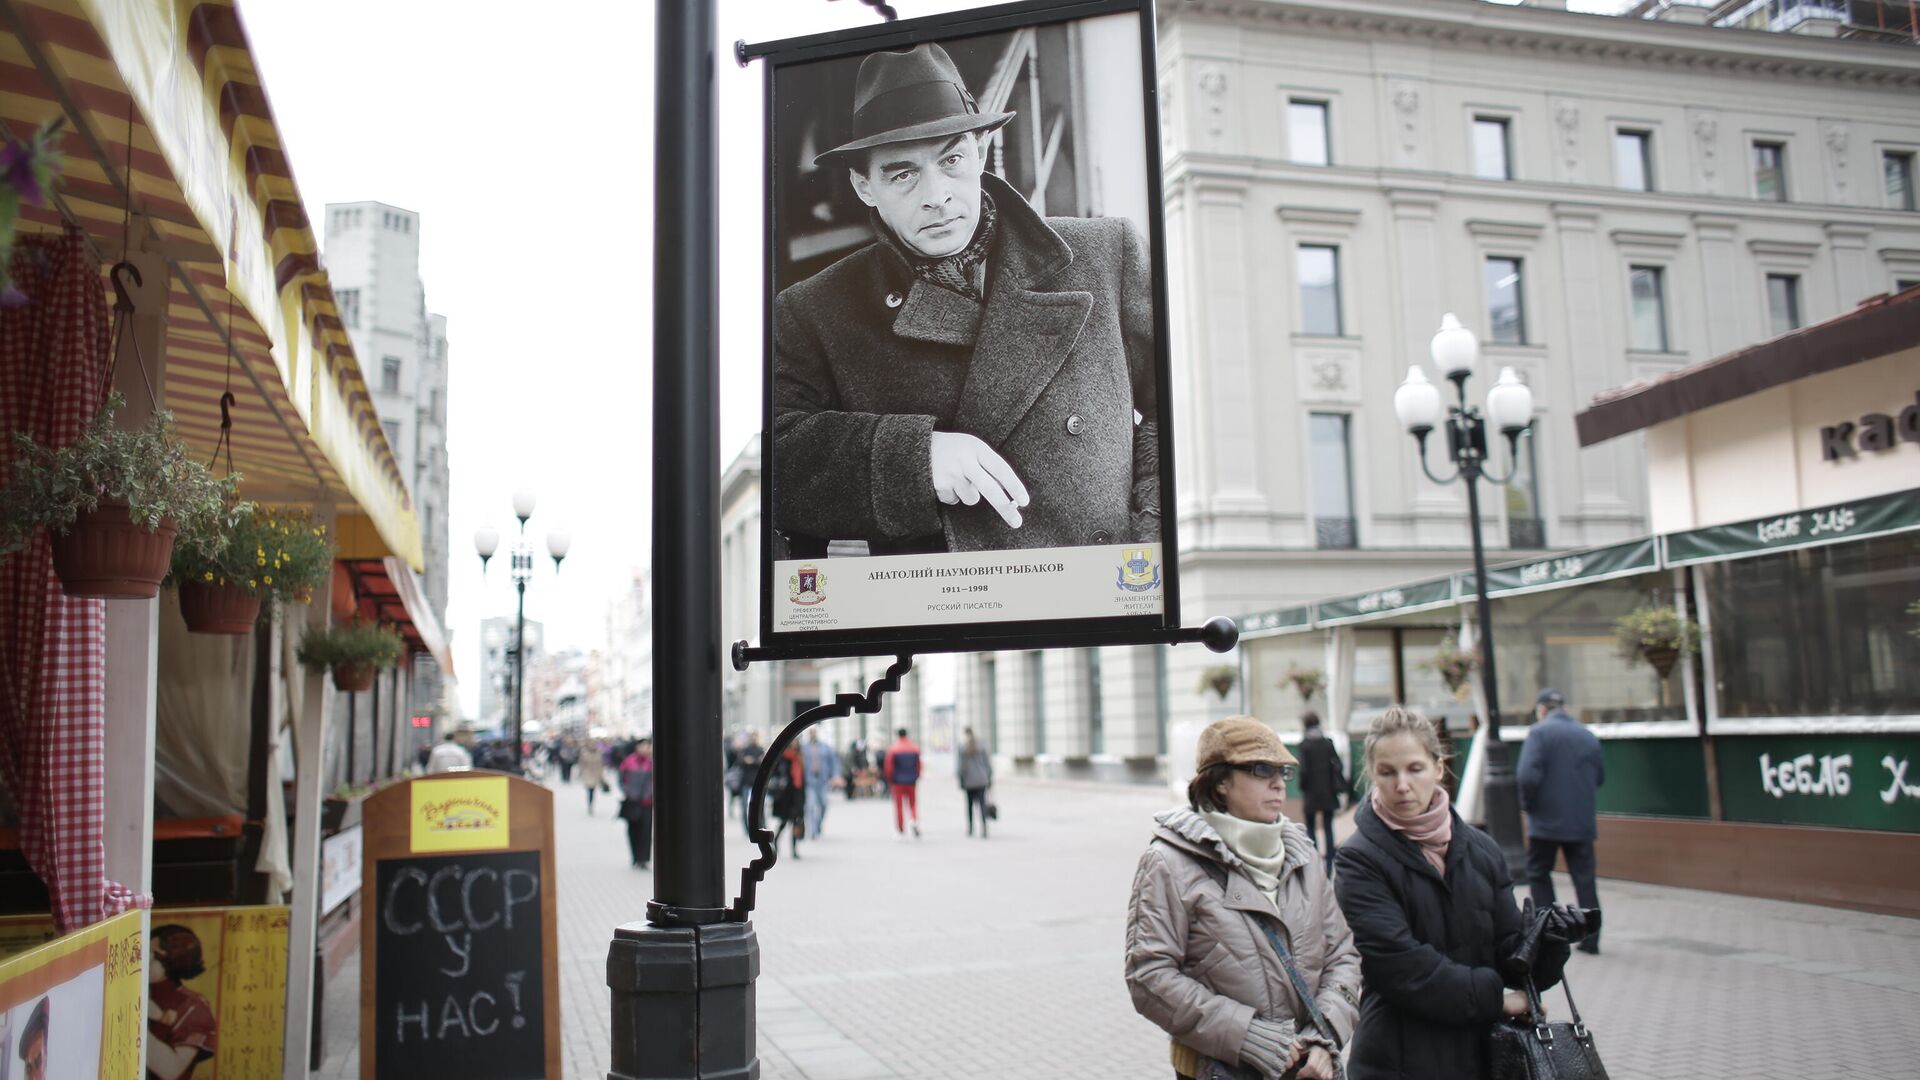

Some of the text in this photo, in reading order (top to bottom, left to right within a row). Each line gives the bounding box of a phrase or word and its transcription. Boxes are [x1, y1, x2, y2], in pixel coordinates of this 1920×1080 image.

[868, 563, 1064, 580] АНАТОЛИЙ НАУМОВИЧ РЫБАКОВ
[927, 601, 1003, 611] РУССКИЙ ПИСАТЕЛЬ
[1114, 594, 1163, 602] ЗНАМЕНИТЫЕ
[1880, 755, 1920, 804] Х
[384, 864, 538, 935] СССР
[396, 970, 526, 1043] НАС!
